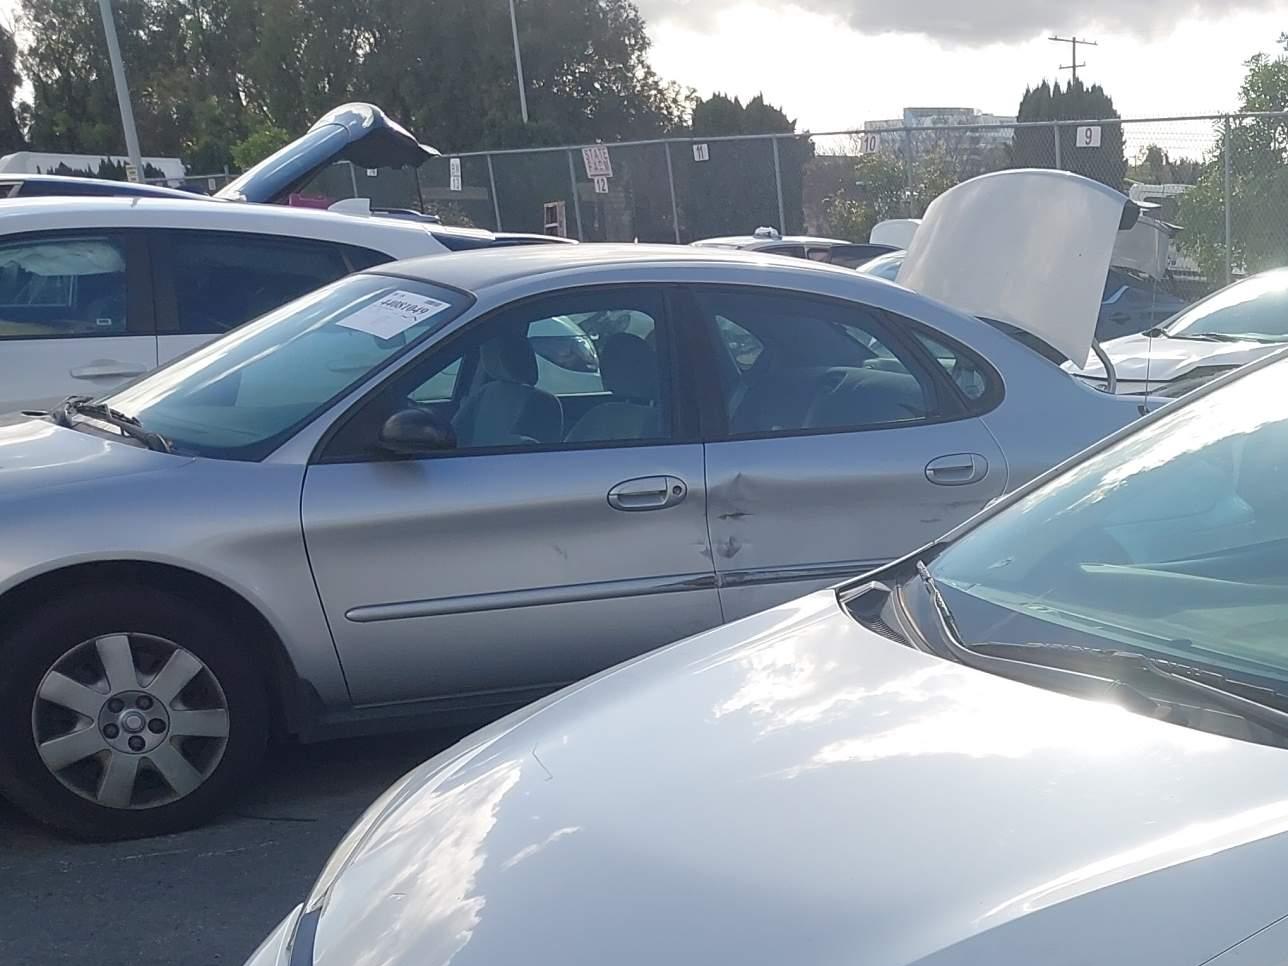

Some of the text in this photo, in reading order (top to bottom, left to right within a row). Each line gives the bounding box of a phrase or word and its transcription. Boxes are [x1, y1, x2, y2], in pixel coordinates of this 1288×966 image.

[1085, 127, 1092, 145] 9
[863, 135, 876, 152] 10
[583, 147, 608, 160] STATE
[696, 146, 706, 160] 11
[595, 178, 607, 192] 12
